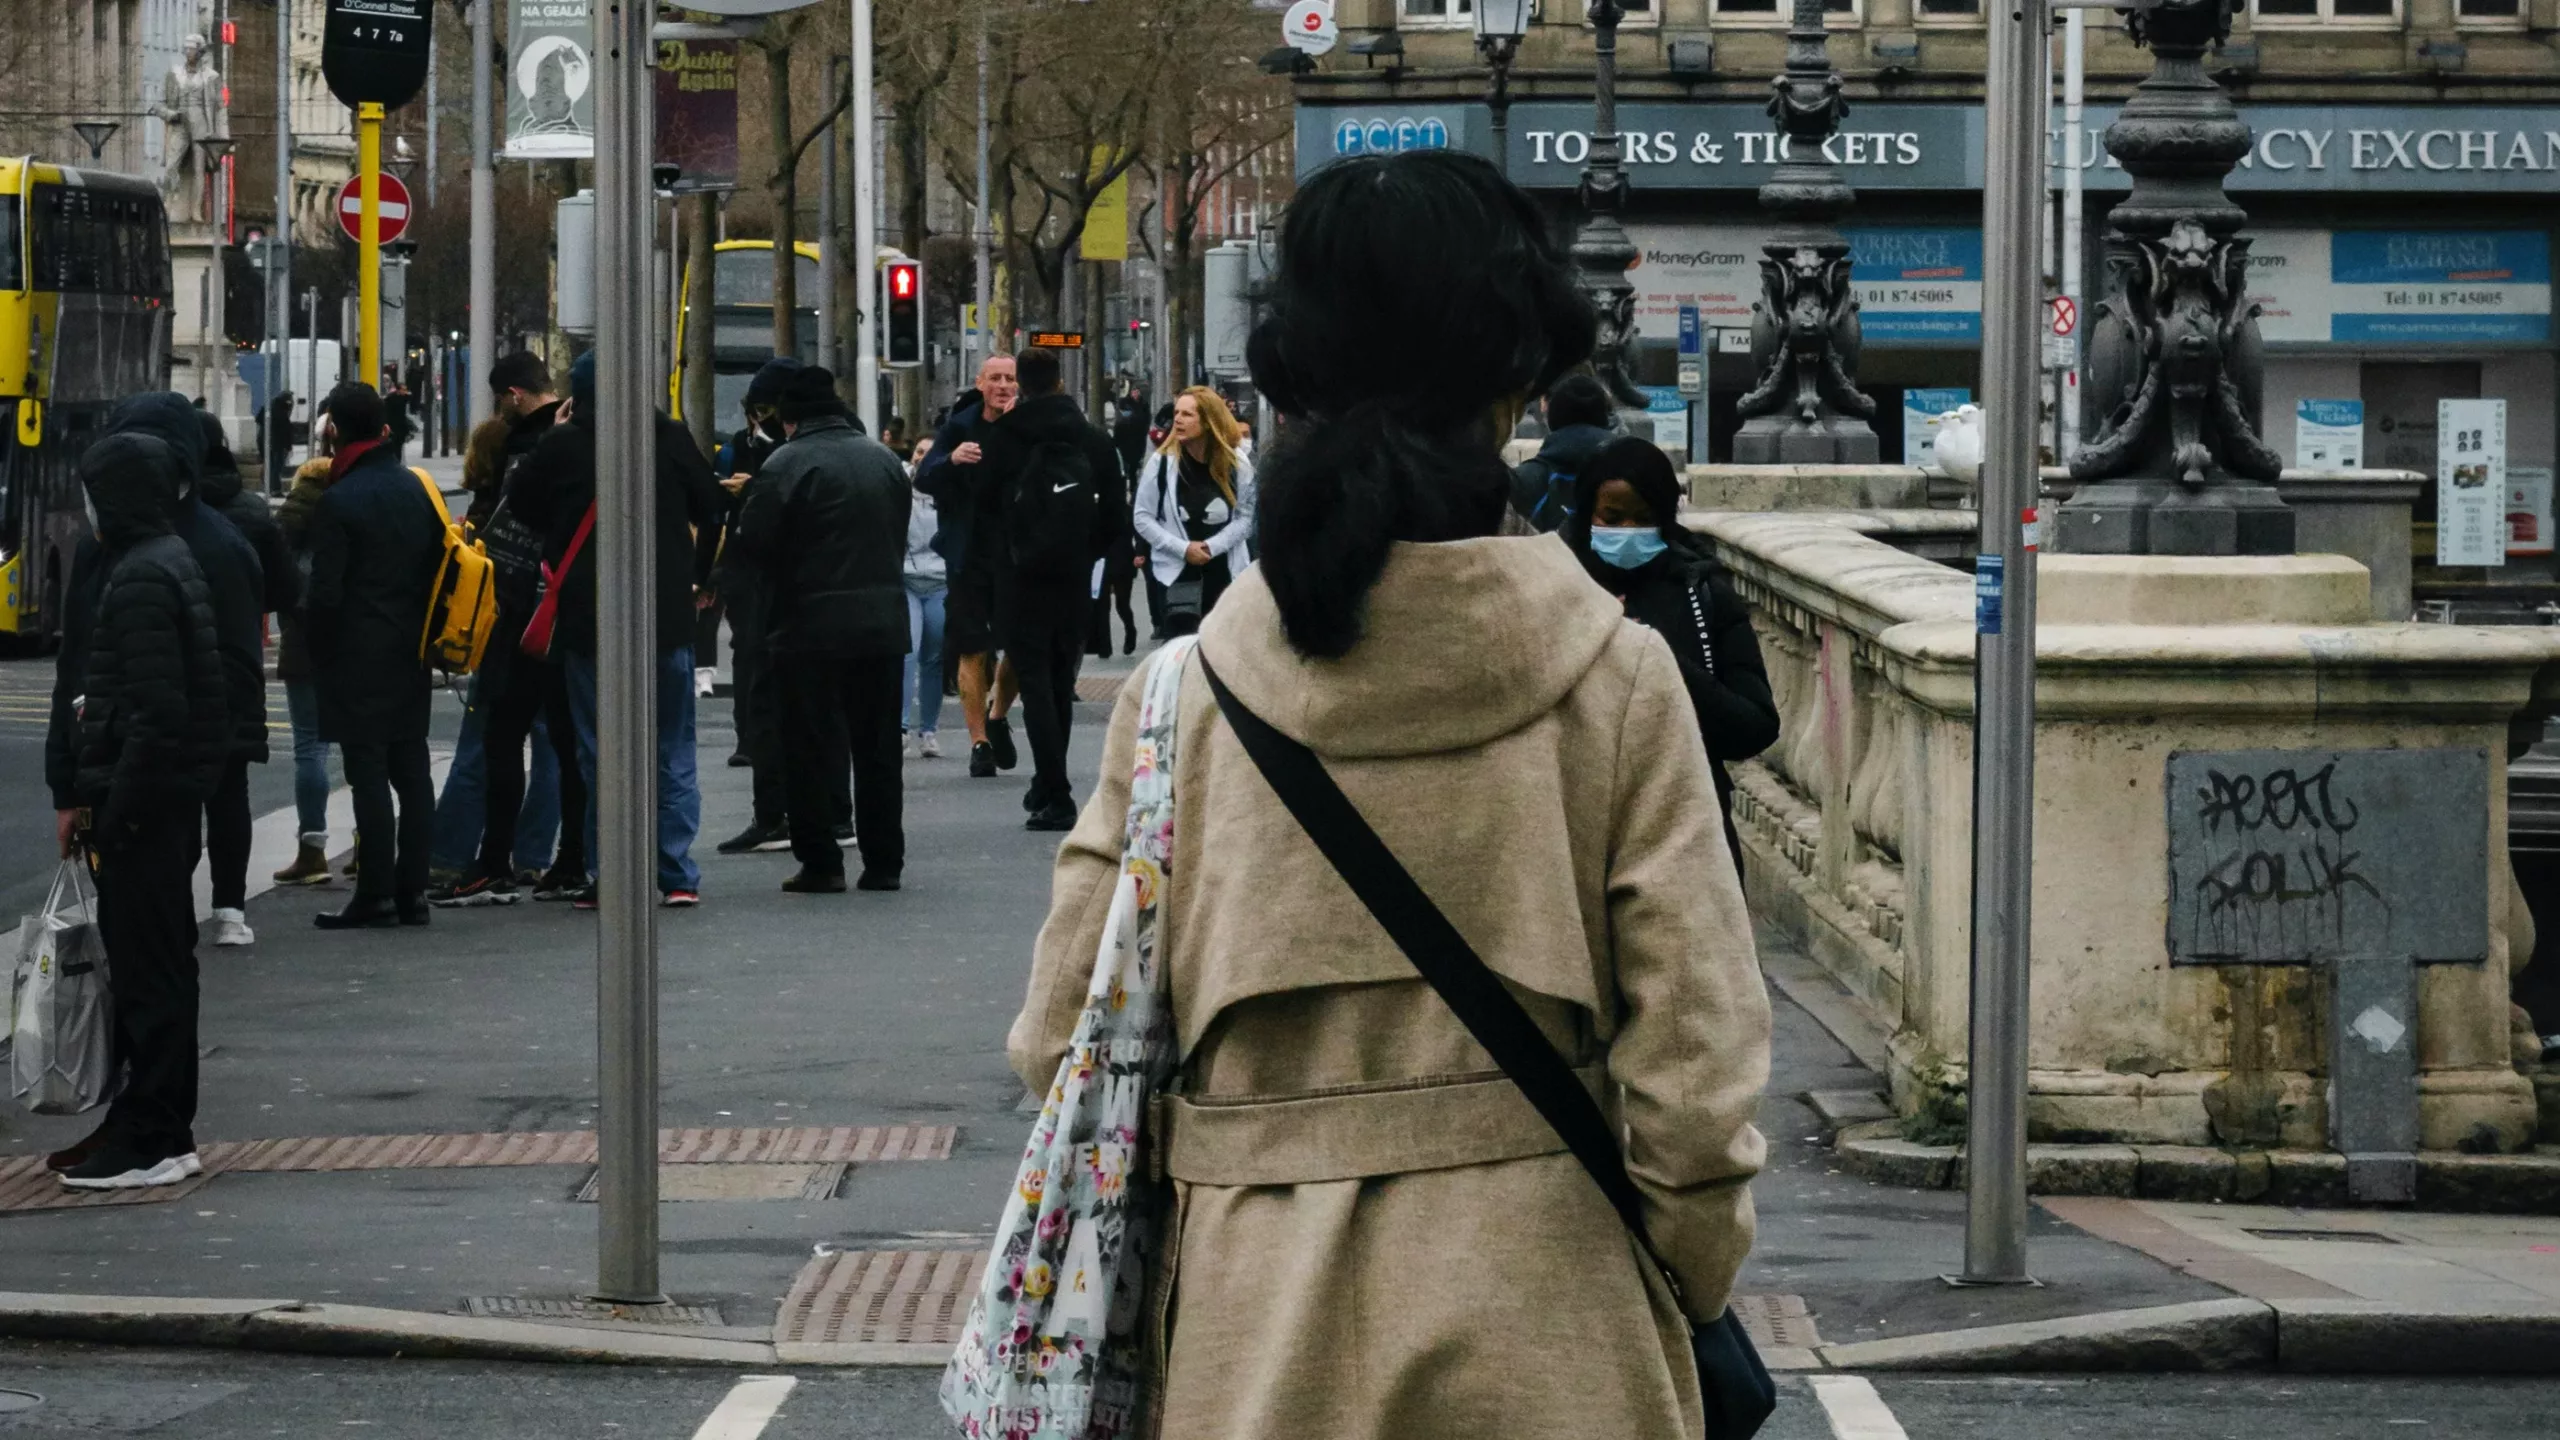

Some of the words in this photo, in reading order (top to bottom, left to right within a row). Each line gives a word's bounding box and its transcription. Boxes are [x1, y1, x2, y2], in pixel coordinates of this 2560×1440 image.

[520, 5, 540, 17] NA
[353, 27, 361, 37] 4
[372, 28, 380, 39] 7
[389, 30, 404, 42] 7a
[1526, 131, 1678, 164] TORS
[1689, 132, 1724, 164] &
[1646, 250, 1745, 267] MoneyGram
[1869, 291, 1885, 302] 01
[1892, 290, 1953, 303] 8745005
[2418, 291, 2434, 304] 01
